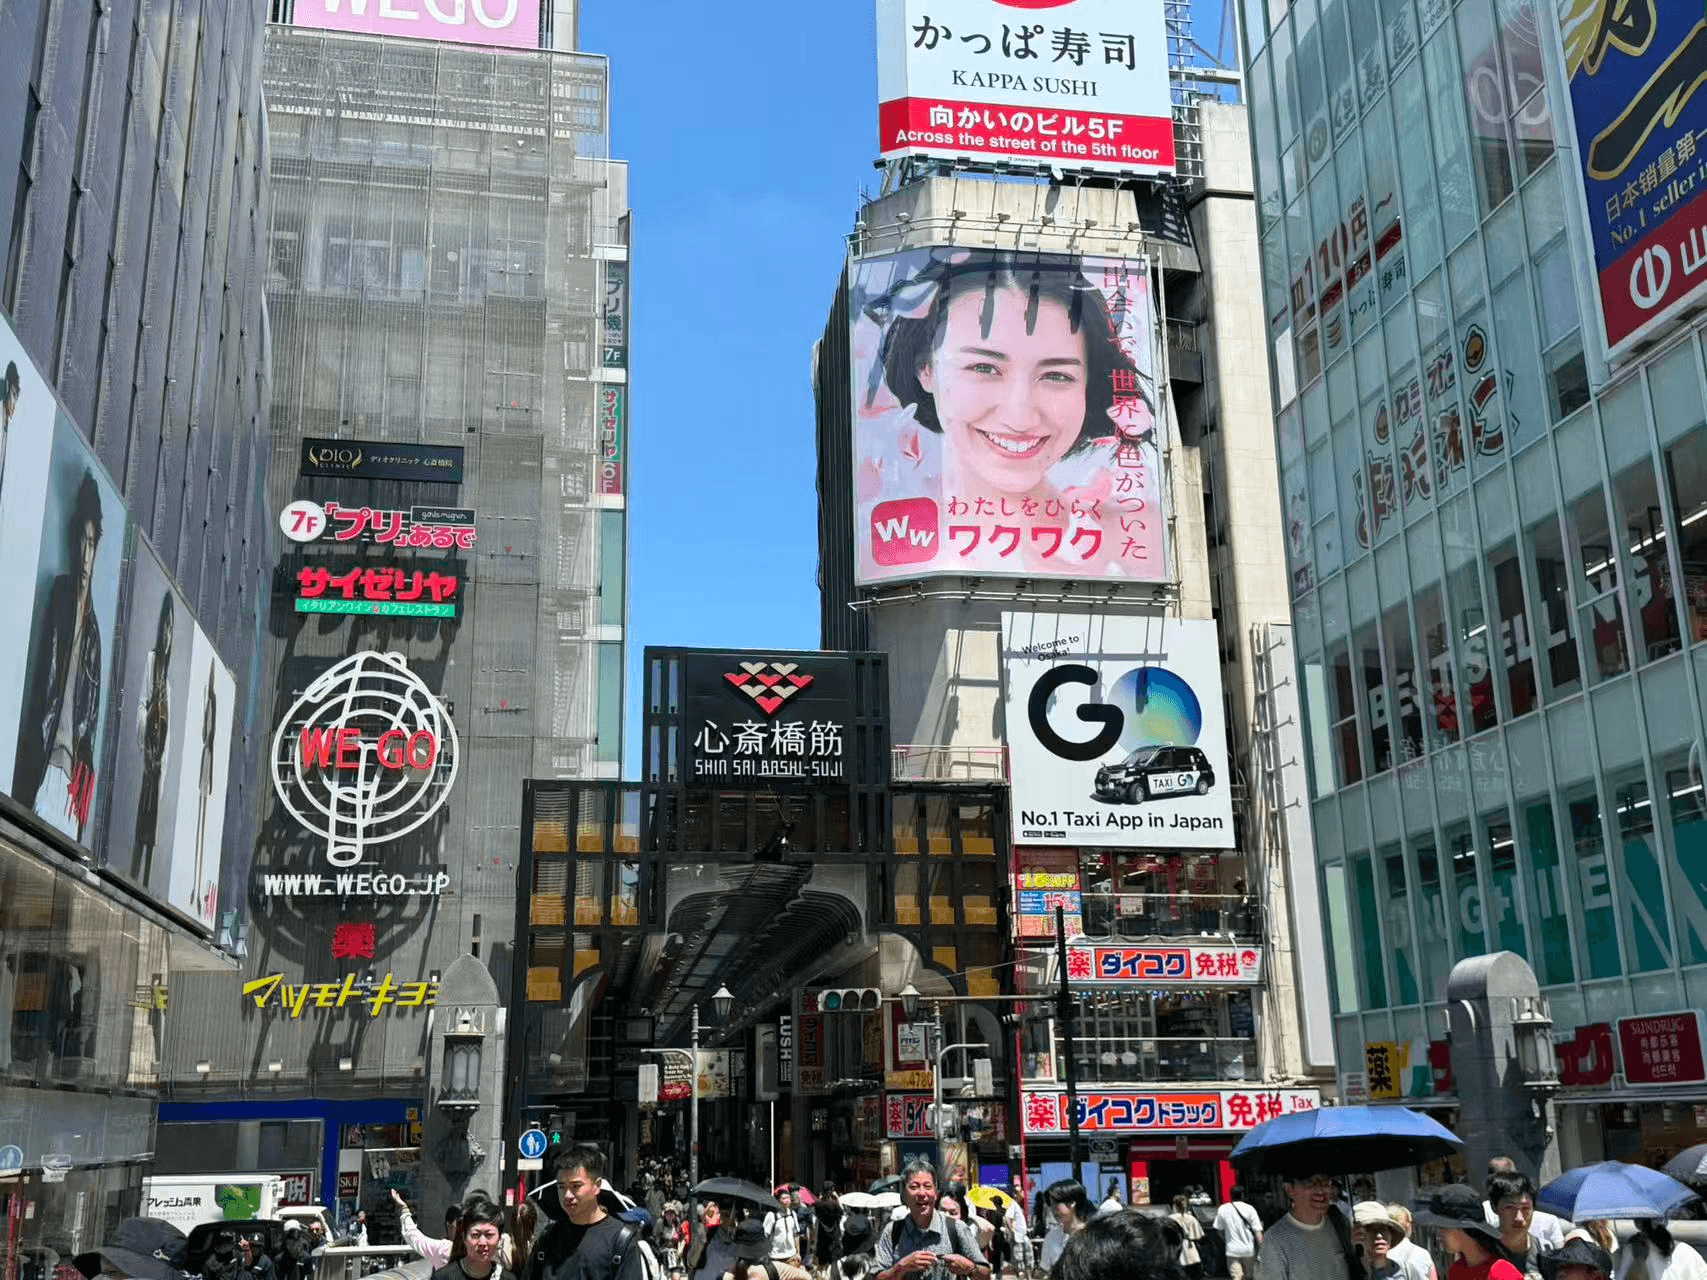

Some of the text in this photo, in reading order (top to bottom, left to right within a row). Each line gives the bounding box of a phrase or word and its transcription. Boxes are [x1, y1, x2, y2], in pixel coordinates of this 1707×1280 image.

[912, 15, 1136, 71] かっぱ寿司
[951, 69, 1098, 97] KAPPA SUSHI
[929, 104, 1123, 139] 向かいのビル5F
[896, 129, 1159, 160] Across the street of the 5th floor
[1606, 128, 1707, 224] 日本销量第一
[1653, 171, 1696, 216] seller
[605, 347, 620, 360] 7F
[290, 510, 318, 533] 7F
[948, 495, 1103, 520] わたしをひらく
[949, 525, 1103, 560] ワクワク
[297, 567, 458, 602] サイゼリヤ
[1021, 635, 1080, 655] Welcome to
[1037, 647, 1070, 661] Osaka!
[1368, 650, 1454, 731] BET
[694, 719, 844, 757] 心斎橋筋
[695, 759, 727, 775] SHIN
[733, 760, 756, 776] SAI
[1153, 778, 1173, 789] TAXI
[1021, 811, 1223, 831] No.1 Taxi App in Japan
[264, 873, 450, 896] WWW.WEGO.JP
[1067, 947, 1240, 979] 薬 ダイコク 免税
[780, 1015, 793, 1060] LUSH
[1630, 1017, 1685, 1035] SUNDRUG
[1366, 1046, 1393, 1091] 薬
[1025, 1093, 1284, 1132] 薬 ダイコクドラッグ 免税
[1289, 1096, 1313, 1109] Tax
